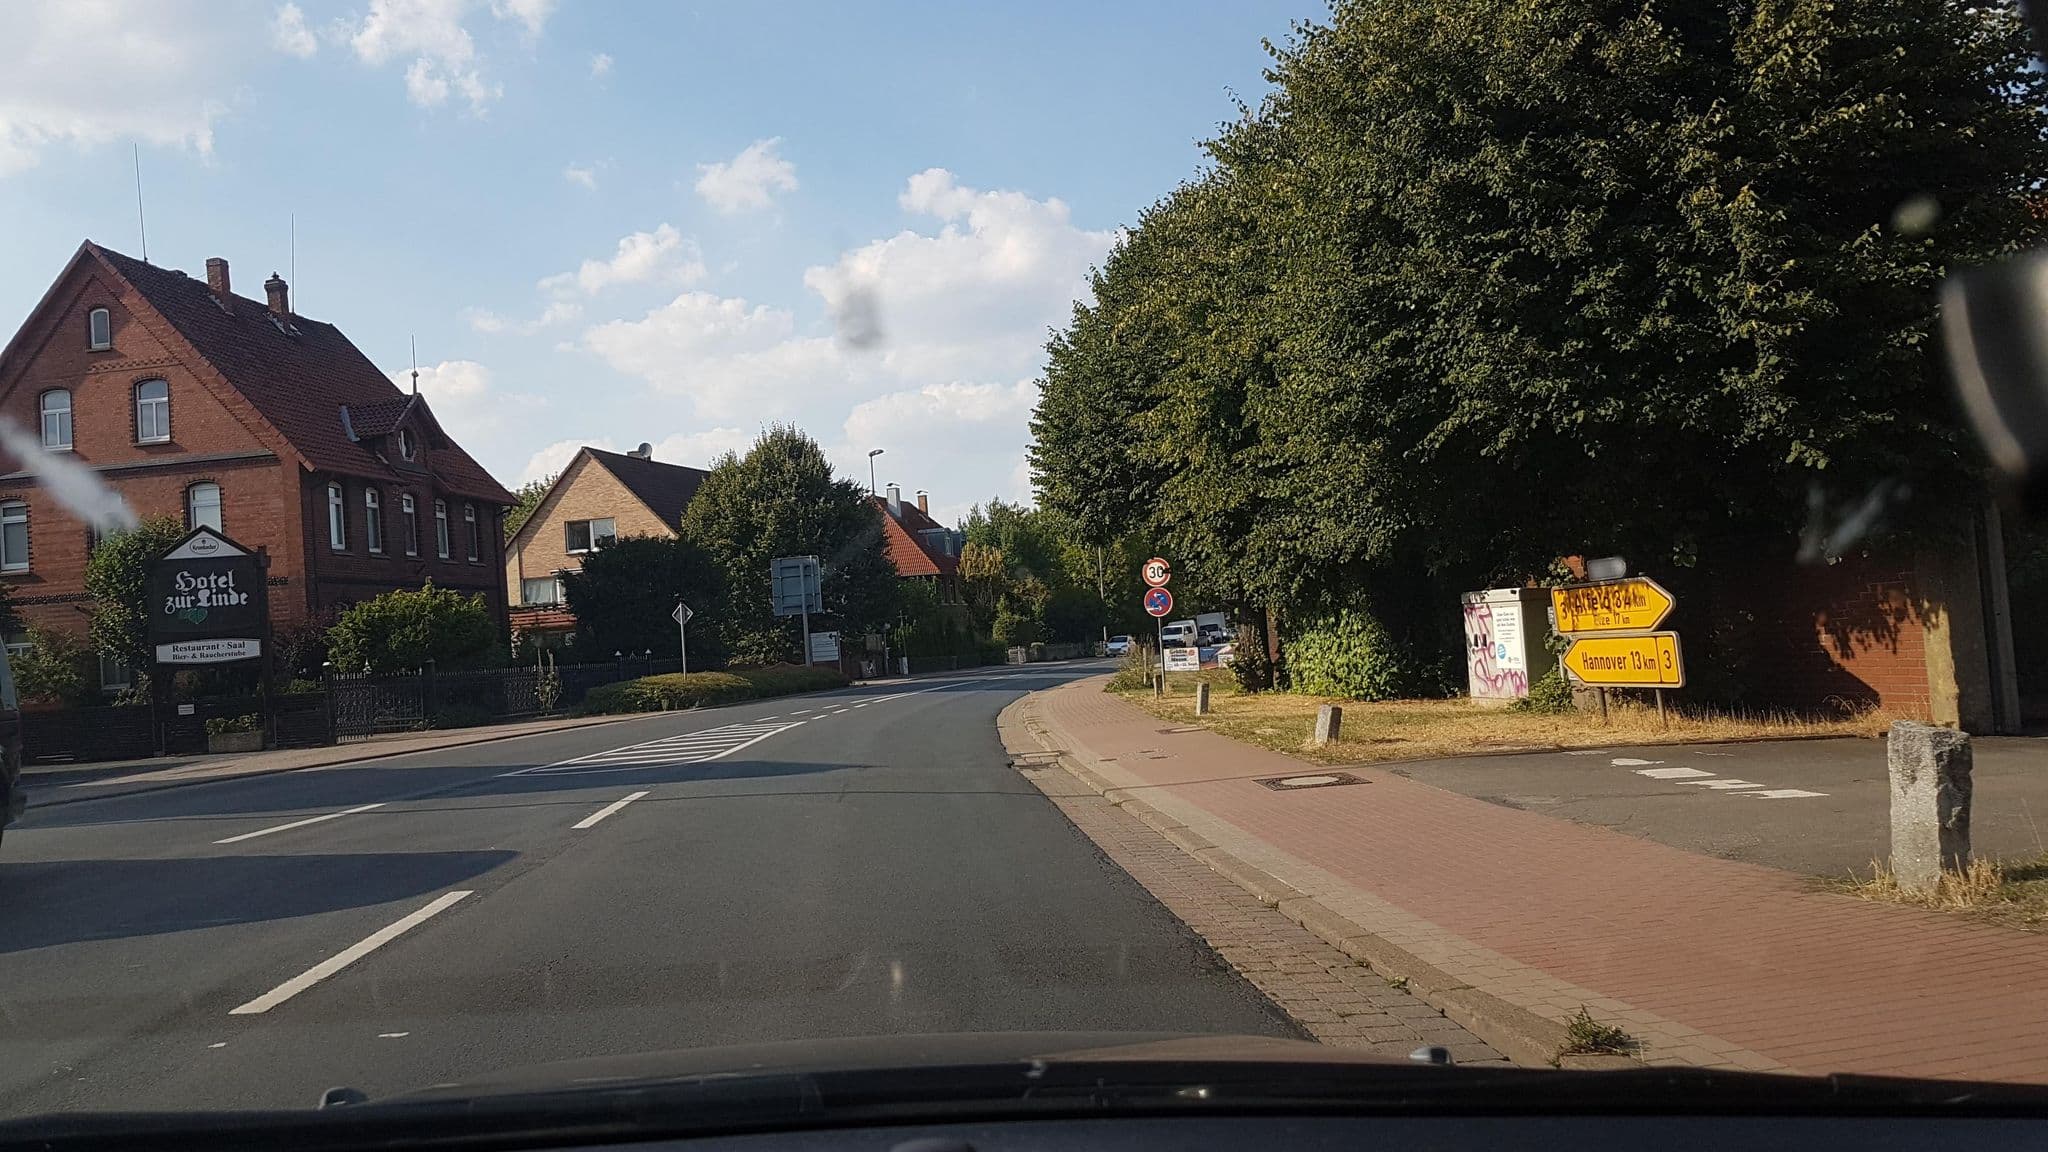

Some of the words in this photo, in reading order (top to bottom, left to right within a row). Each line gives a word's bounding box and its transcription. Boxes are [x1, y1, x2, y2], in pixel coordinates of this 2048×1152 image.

[1149, 565, 1164, 579] 30
[175, 569, 235, 594] Hotel
[164, 594, 197, 615] zur
[197, 588, 248, 607] Linde
[1560, 601, 1568, 620] 3
[1575, 589, 1611, 614] Alfeld
[1633, 592, 1647, 607] km
[1613, 612, 1620, 625] 17
[1622, 615, 1631, 624] km
[172, 643, 220, 653] Restaurant
[227, 641, 245, 650] Saal
[172, 653, 189, 661] Bier-
[191, 652, 198, 660] &
[1582, 651, 1627, 670] Hannover
[1630, 650, 1642, 670] 13
[1644, 656, 1657, 670] km
[1663, 649, 1672, 670] 3
